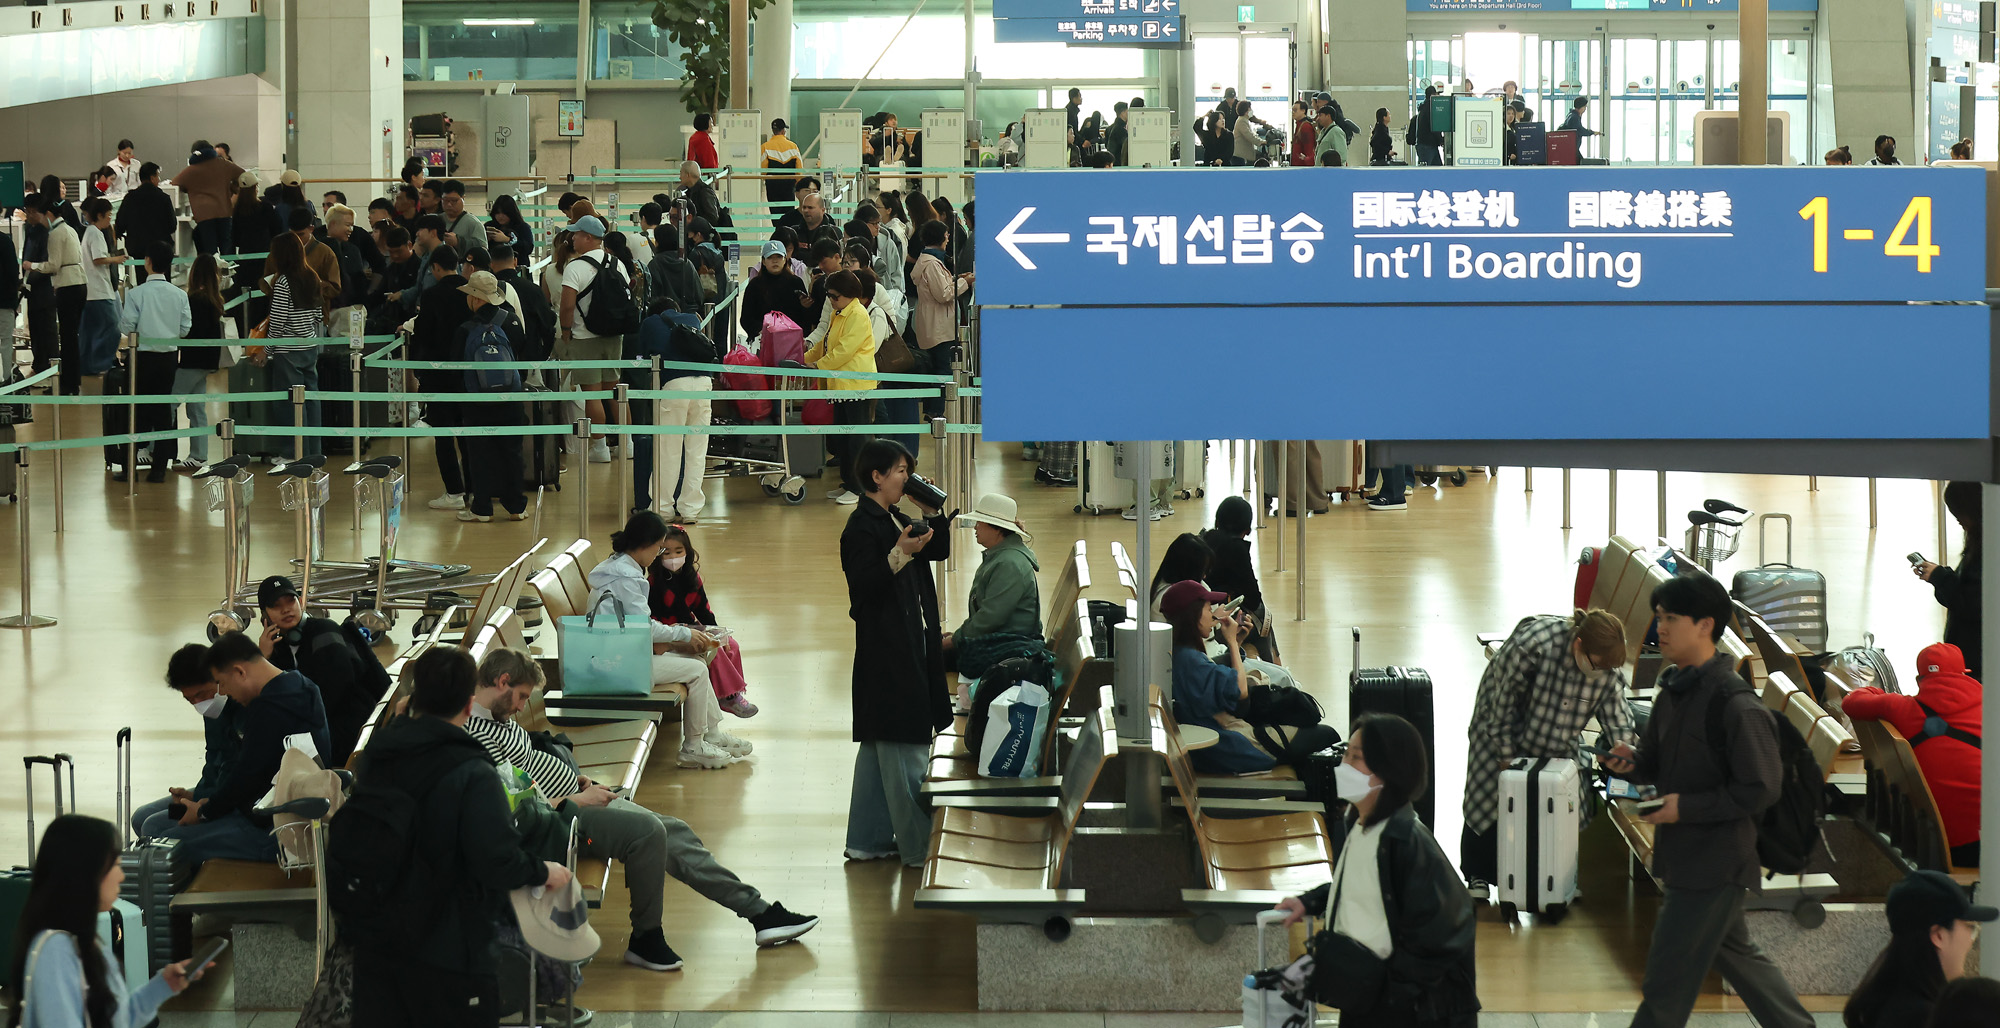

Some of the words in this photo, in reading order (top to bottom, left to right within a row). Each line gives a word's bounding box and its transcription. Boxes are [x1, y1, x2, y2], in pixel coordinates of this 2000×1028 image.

[1083, 6, 1115, 14] Arrivals
[1072, 31, 1104, 41] Parking
[1108, 24, 1138, 37] 주차장
[1352, 189, 1520, 228] 国际线登机
[1568, 189, 1733, 229] 国際線搭乗
[1086, 211, 1325, 265] 국제선탑승
[1798, 196, 1940, 273] 1-4
[1352, 241, 1432, 279] Int'l
[1449, 241, 1642, 288] Boarding
[1009, 739, 1021, 758] DUTY
